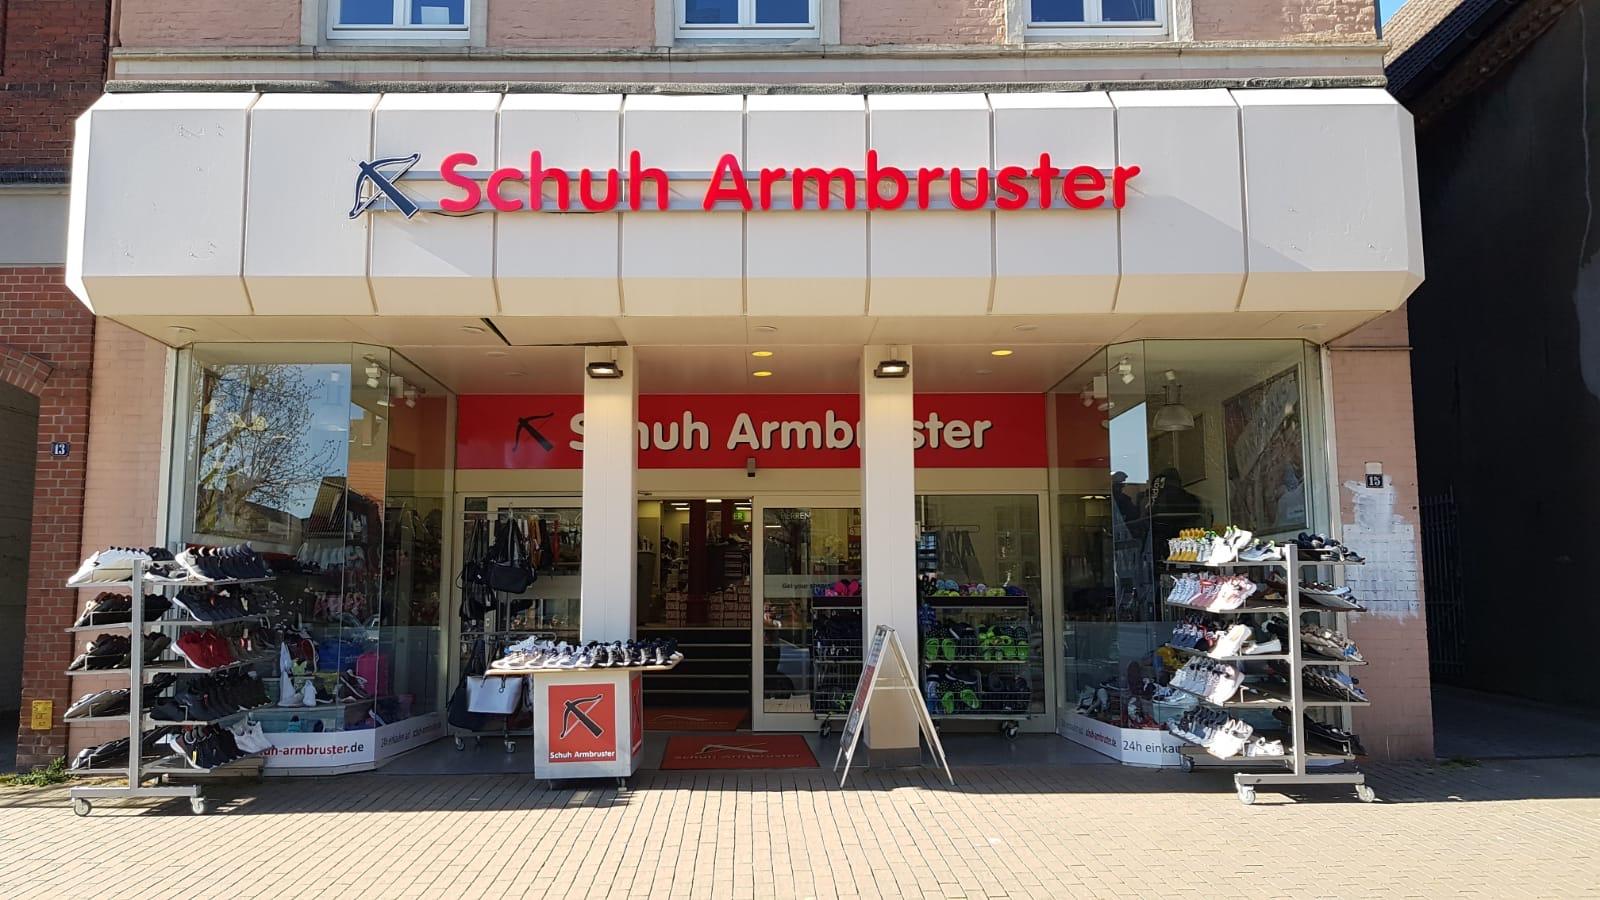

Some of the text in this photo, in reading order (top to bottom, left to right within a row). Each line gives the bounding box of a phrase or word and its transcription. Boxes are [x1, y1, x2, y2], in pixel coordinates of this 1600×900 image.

[439, 149, 1141, 213] Schuh Armbruster
[54, 443, 65, 455] 13
[1368, 476, 1381, 486] 15
[1122, 740, 1142, 752] 24h
[550, 749, 615, 759] Schuh Armbruster
